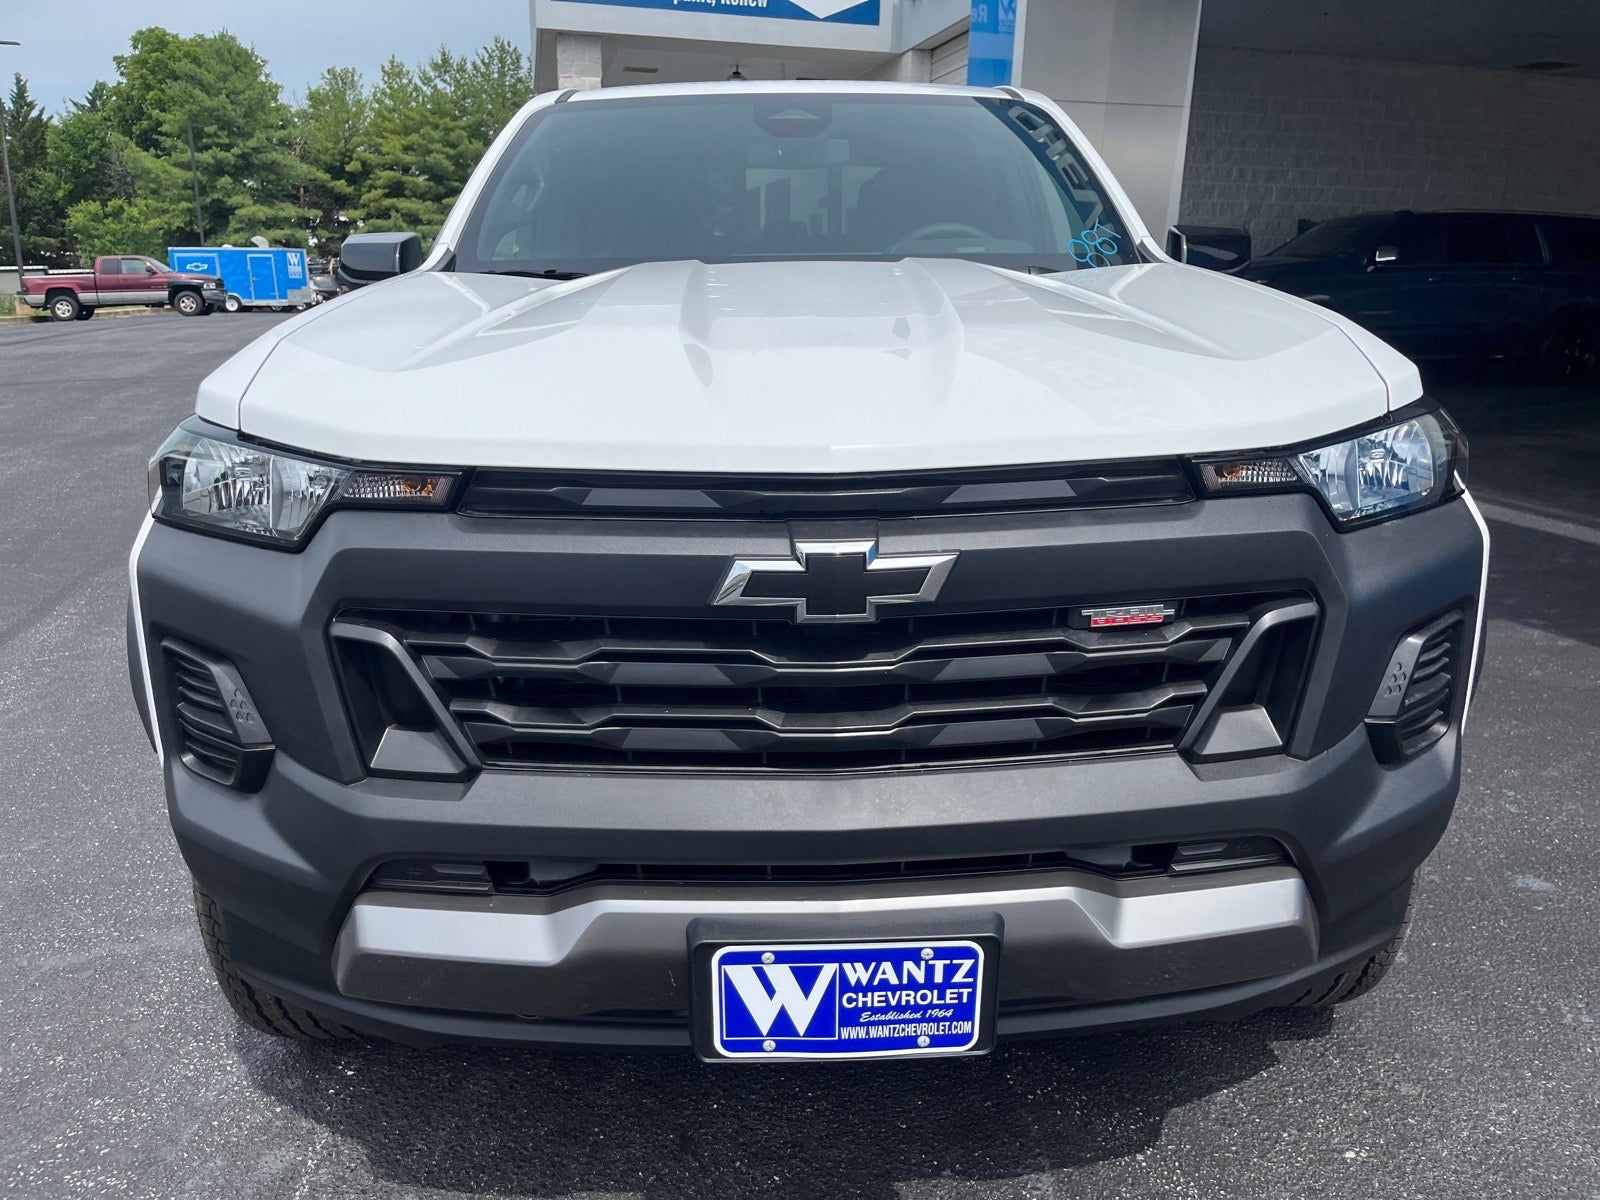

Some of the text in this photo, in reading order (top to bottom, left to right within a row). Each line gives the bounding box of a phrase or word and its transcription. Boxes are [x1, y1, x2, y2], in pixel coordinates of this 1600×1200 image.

[842, 959, 975, 987] WANTZ
[722, 964, 839, 1038] W
[842, 988, 973, 1009] CHEVROLET
[859, 1007, 954, 1023] Established 1964
[840, 1020, 972, 1040] WWW.WANTZCHEVROLET.COM
